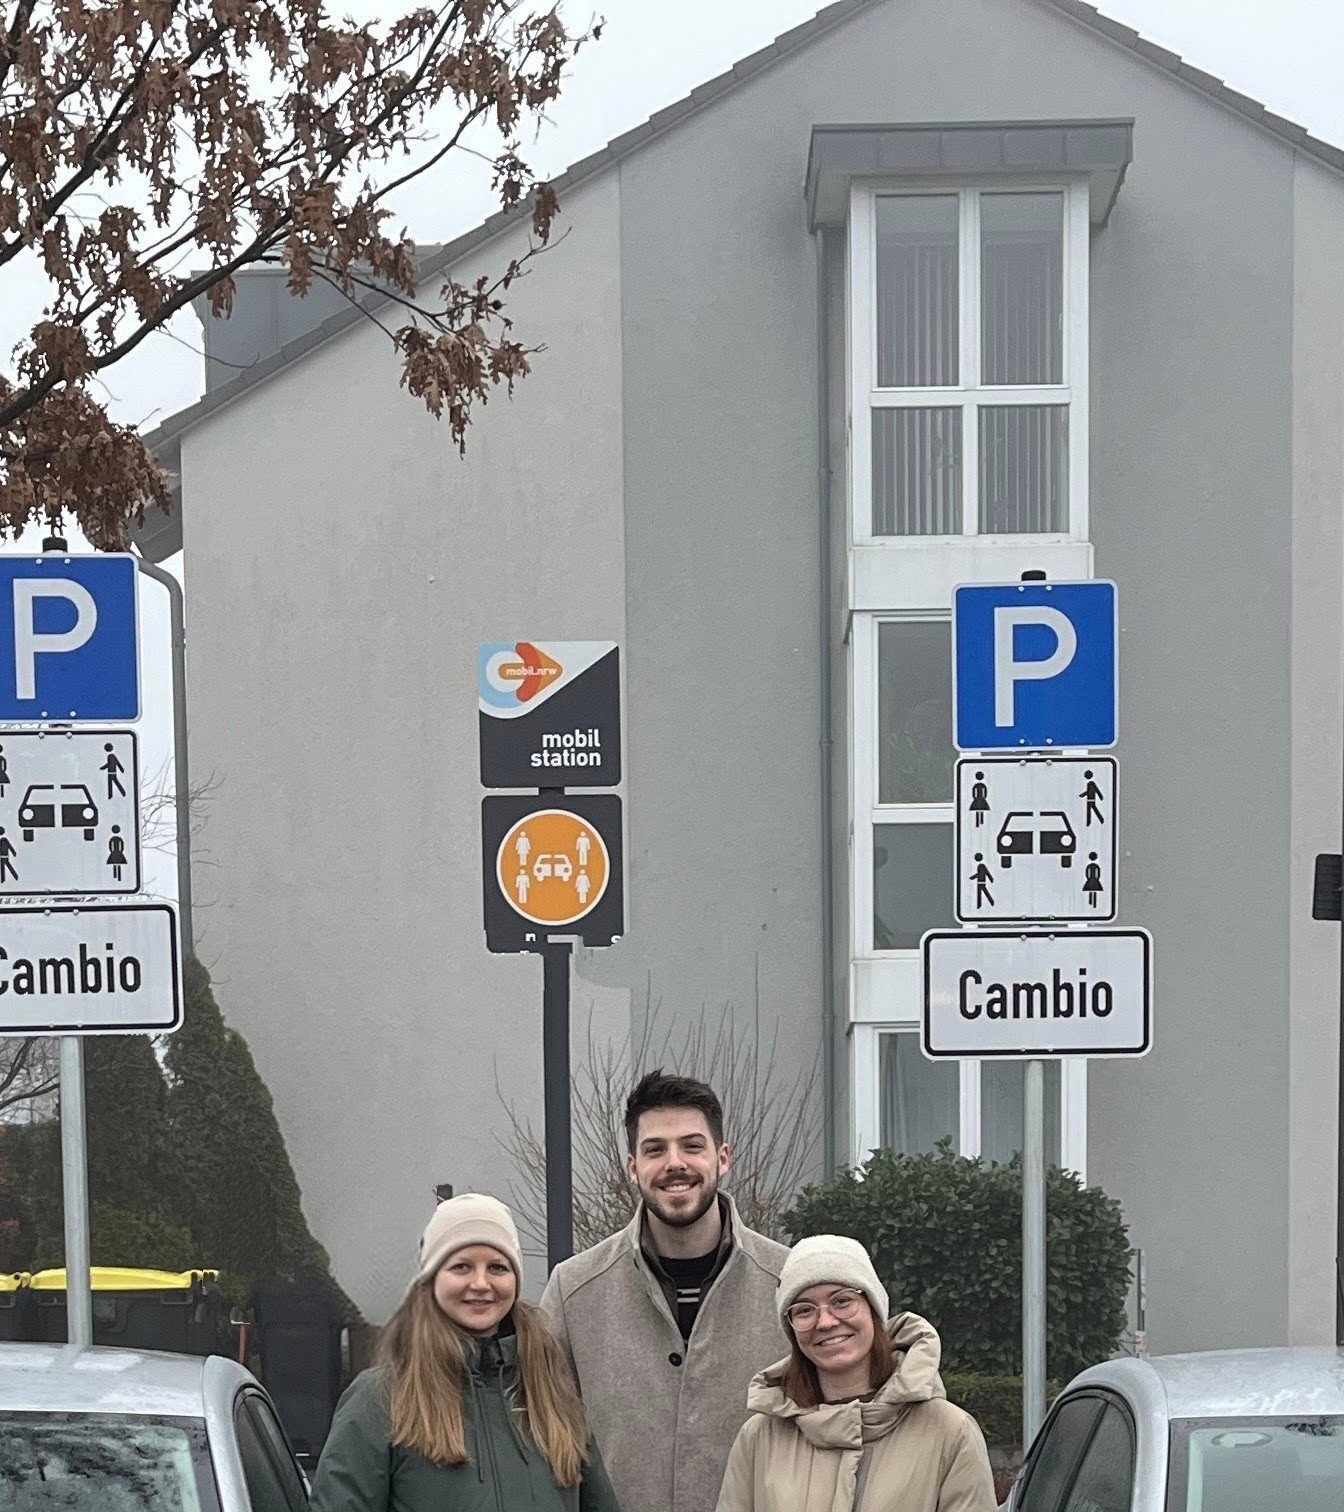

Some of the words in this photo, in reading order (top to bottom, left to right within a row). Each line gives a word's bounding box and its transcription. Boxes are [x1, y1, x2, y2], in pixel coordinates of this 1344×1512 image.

[12, 577, 98, 700] P
[993, 605, 1077, 728] P
[530, 748, 601, 767] station
[541, 728, 601, 748] mobil
[958, 966, 1114, 1020] Cambio
